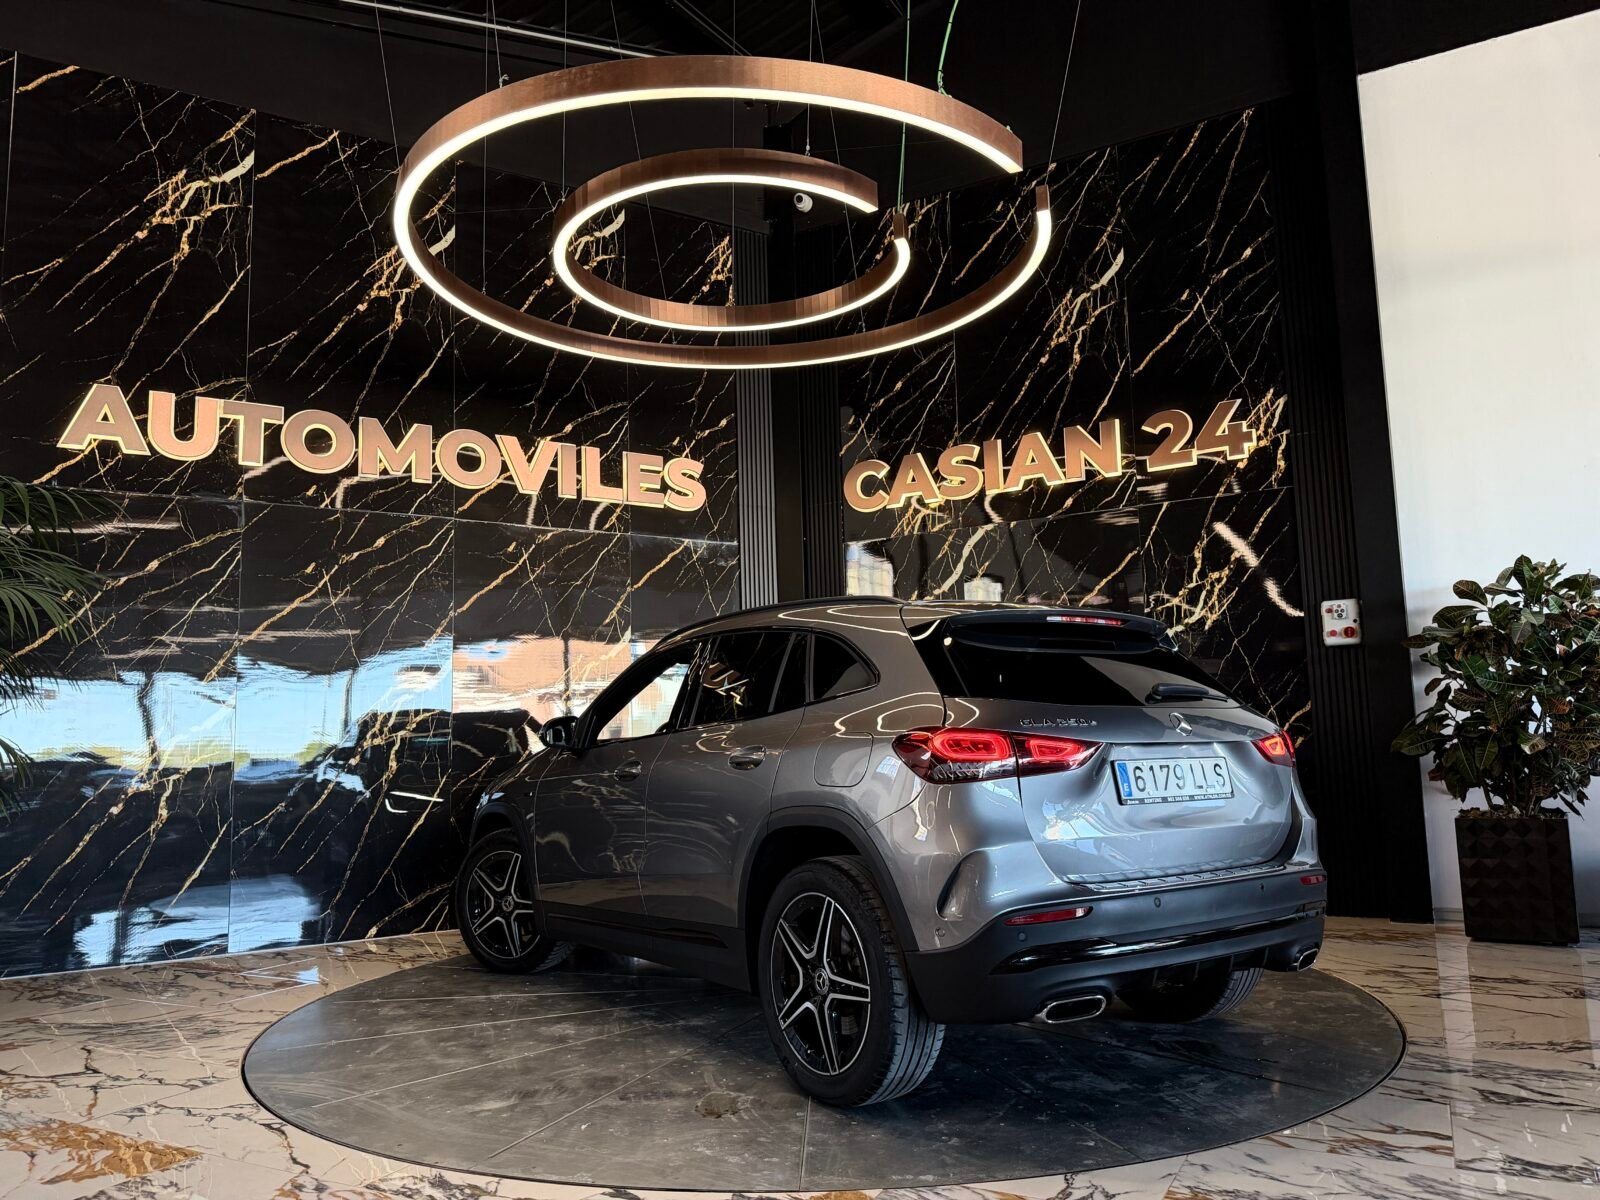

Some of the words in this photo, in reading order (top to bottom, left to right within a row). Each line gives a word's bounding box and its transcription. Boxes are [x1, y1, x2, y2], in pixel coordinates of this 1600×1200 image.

[57, 383, 707, 512] AUTOMOVILES
[843, 418, 1124, 513] CASIAN
[1141, 398, 1257, 473] 24
[1123, 783, 1130, 792] E
[1133, 763, 1186, 793] 6179
[1190, 762, 1226, 790] LLS
